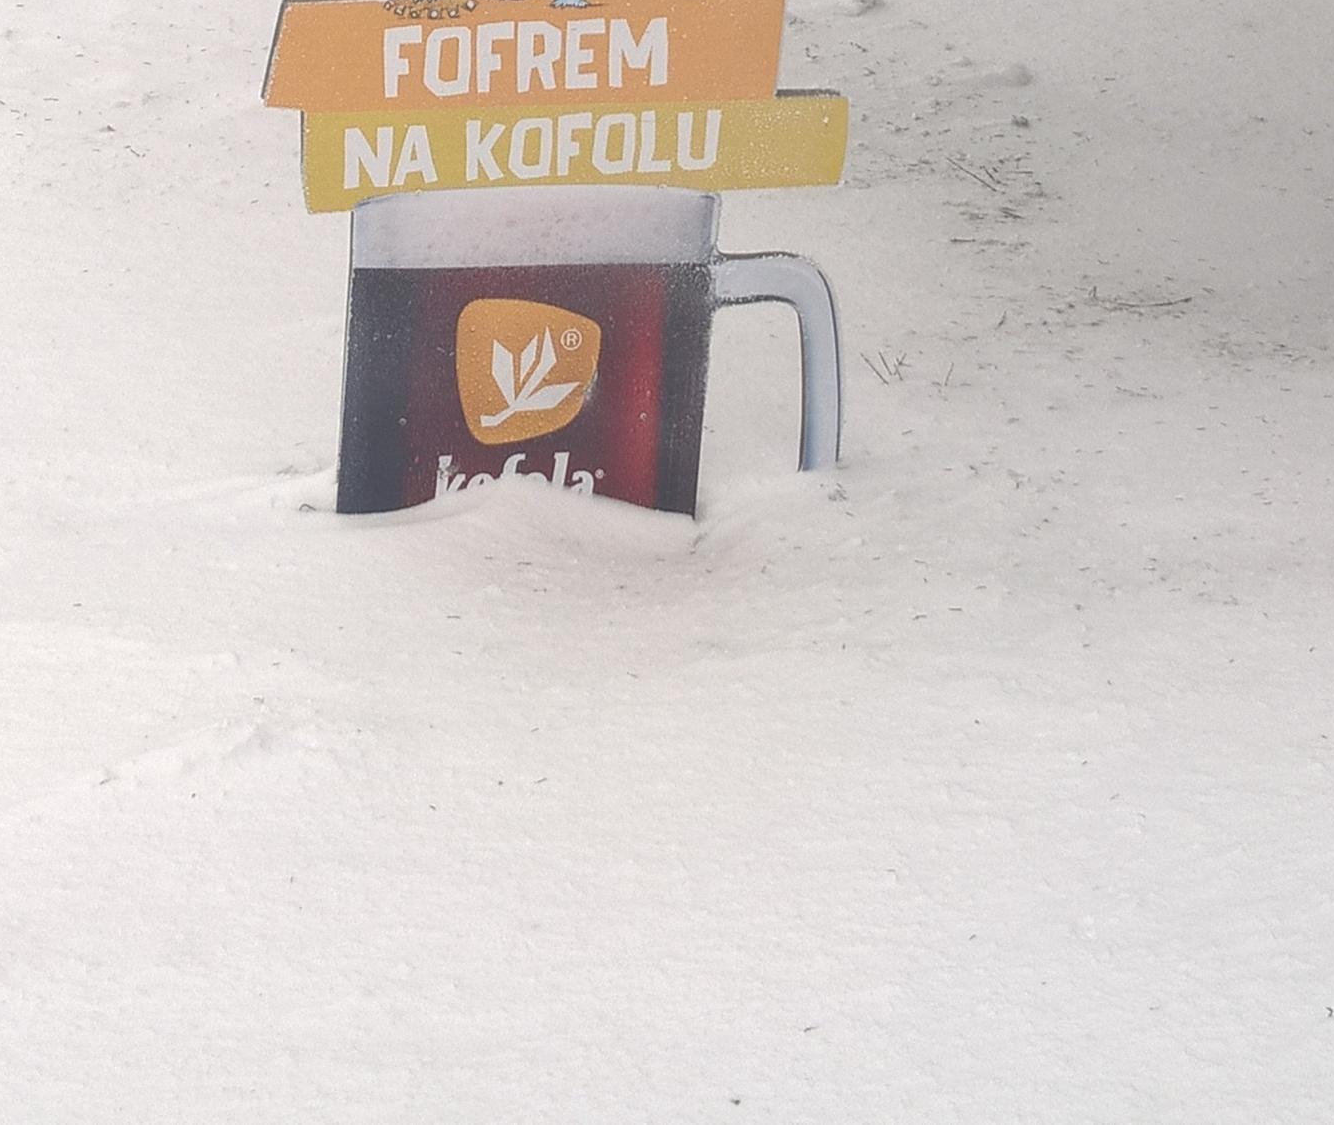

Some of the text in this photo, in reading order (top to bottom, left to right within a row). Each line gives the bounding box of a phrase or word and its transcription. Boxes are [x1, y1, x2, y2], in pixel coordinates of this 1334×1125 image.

[384, 18, 668, 97] FOFREM
[344, 110, 722, 189] NA KOFOLU
